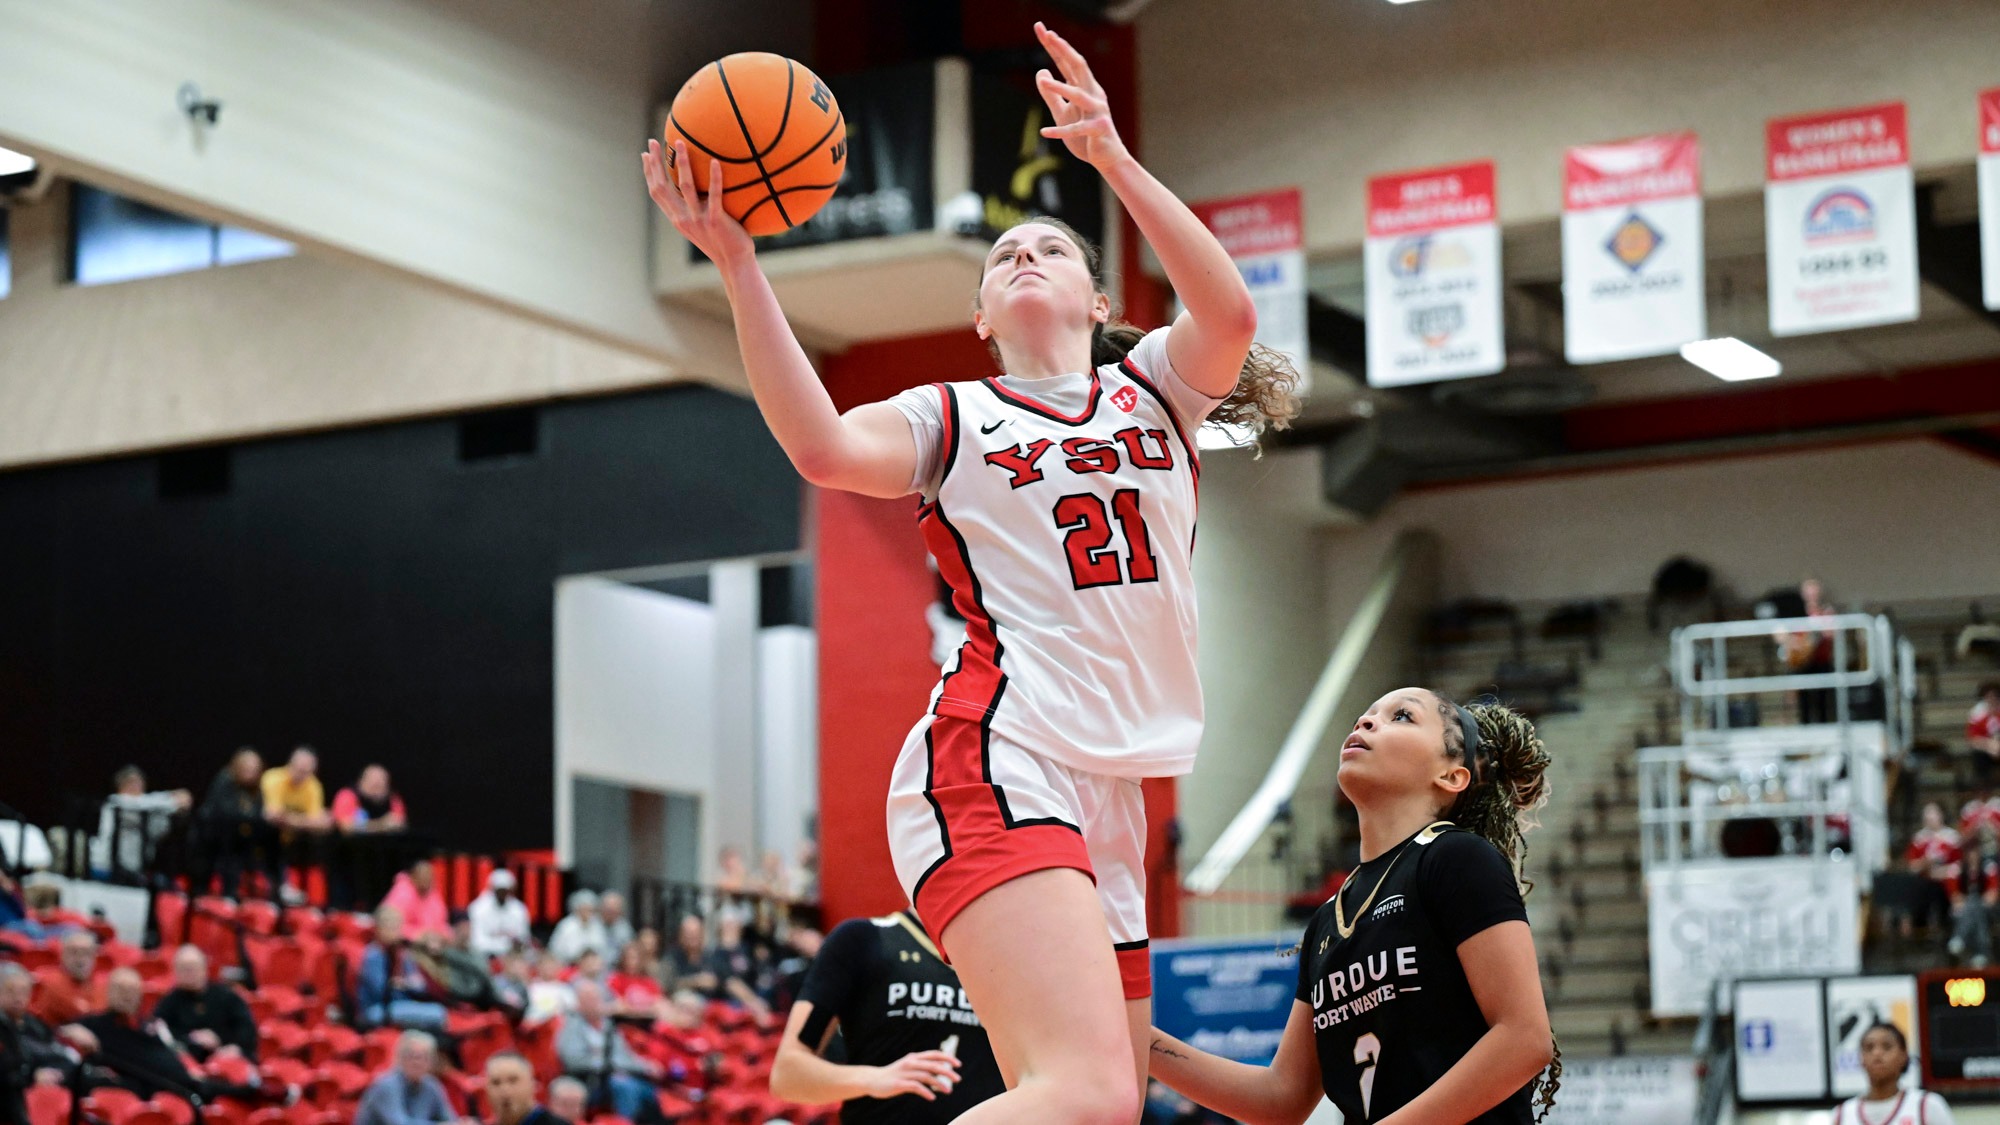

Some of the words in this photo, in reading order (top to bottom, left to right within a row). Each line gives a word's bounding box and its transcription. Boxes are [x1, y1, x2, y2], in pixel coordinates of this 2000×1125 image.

[984, 426, 1174, 490] YSU
[1052, 488, 1159, 591] 21
[1373, 898, 1404, 916] HORIZON
[1311, 946, 1418, 1010] URDUE
[906, 1004, 948, 1021] FORT
